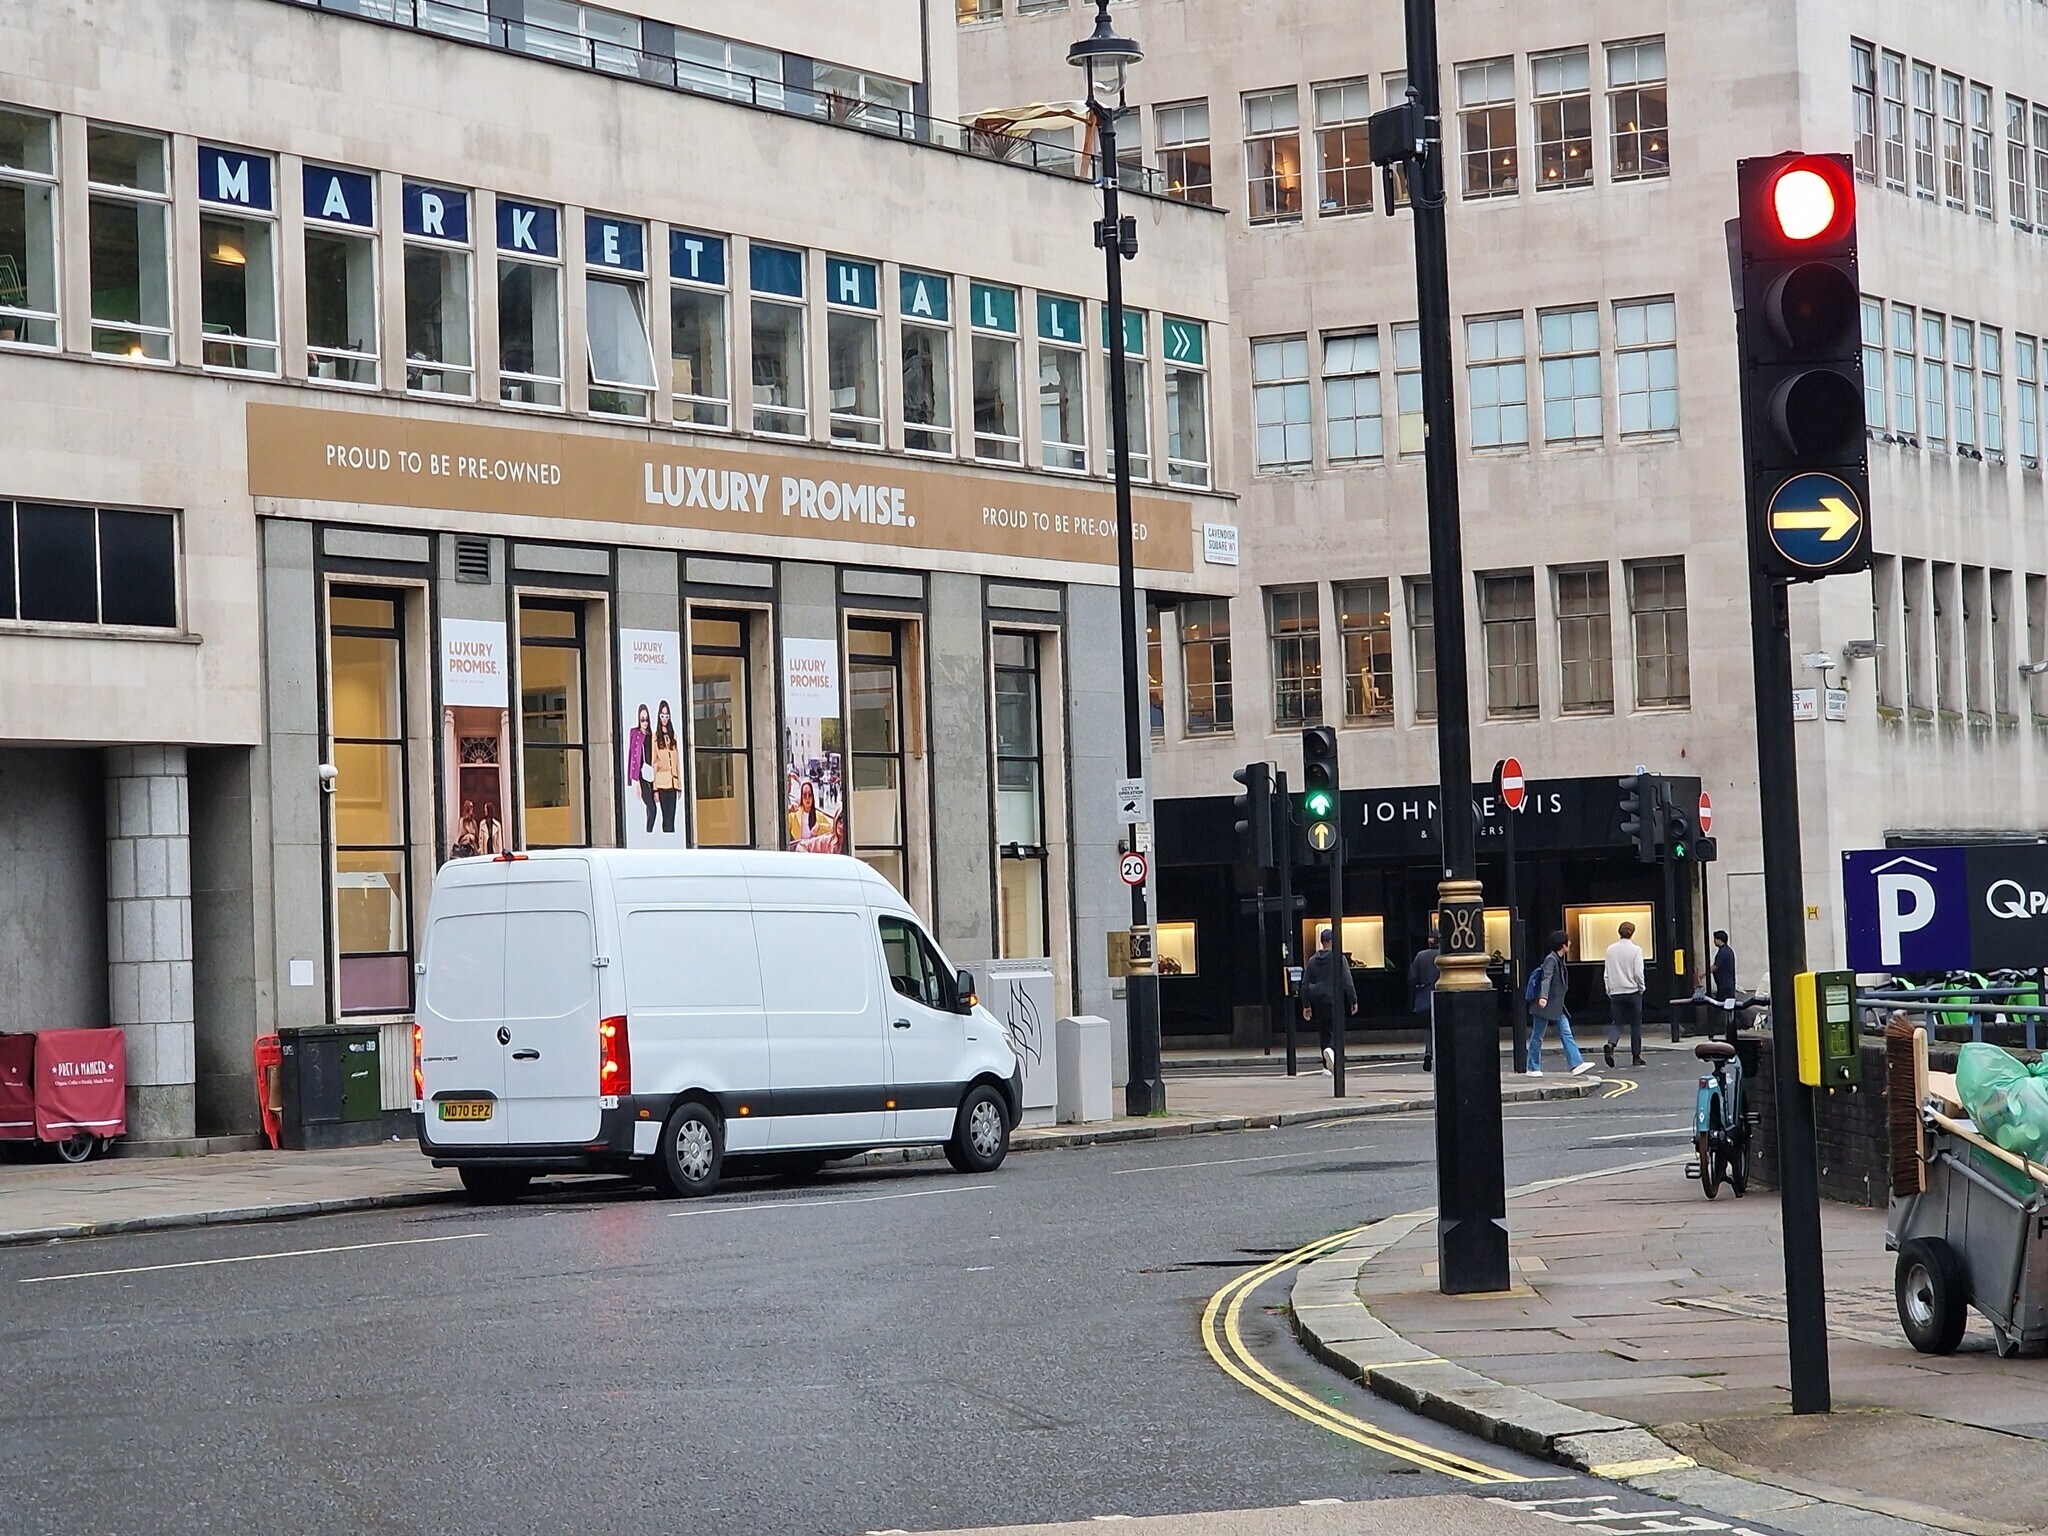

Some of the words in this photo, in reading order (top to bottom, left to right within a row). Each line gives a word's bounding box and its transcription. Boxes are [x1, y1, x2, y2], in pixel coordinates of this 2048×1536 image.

[217, 156, 704, 278] MARKET
[326, 444, 391, 471] PROUD
[397, 450, 422, 474] TO
[430, 455, 450, 477] BE
[458, 455, 561, 486] PRE-OWNED
[644, 462, 770, 514] LUXURY
[781, 477, 916, 529] PROMISE.
[982, 506, 1028, 529] PROUD
[1032, 512, 1050, 532] TO
[1055, 514, 1069, 534] BE
[1074, 516, 1148, 541] PRE-OED
[448, 641, 493, 657] LUXURY
[633, 641, 663, 652] LUXURY
[633, 653, 668, 664] PROMISE.
[789, 659, 826, 672] LUXURY
[449, 659, 500, 675] PROMISE.
[790, 674, 833, 689] PROMISE.
[1123, 862, 1143, 876] 20
[1877, 873, 1937, 966] P
[58, 1062, 73, 1077] PRET
[444, 1104, 470, 1117] ND70
[471, 1104, 490, 1117] EPZ
